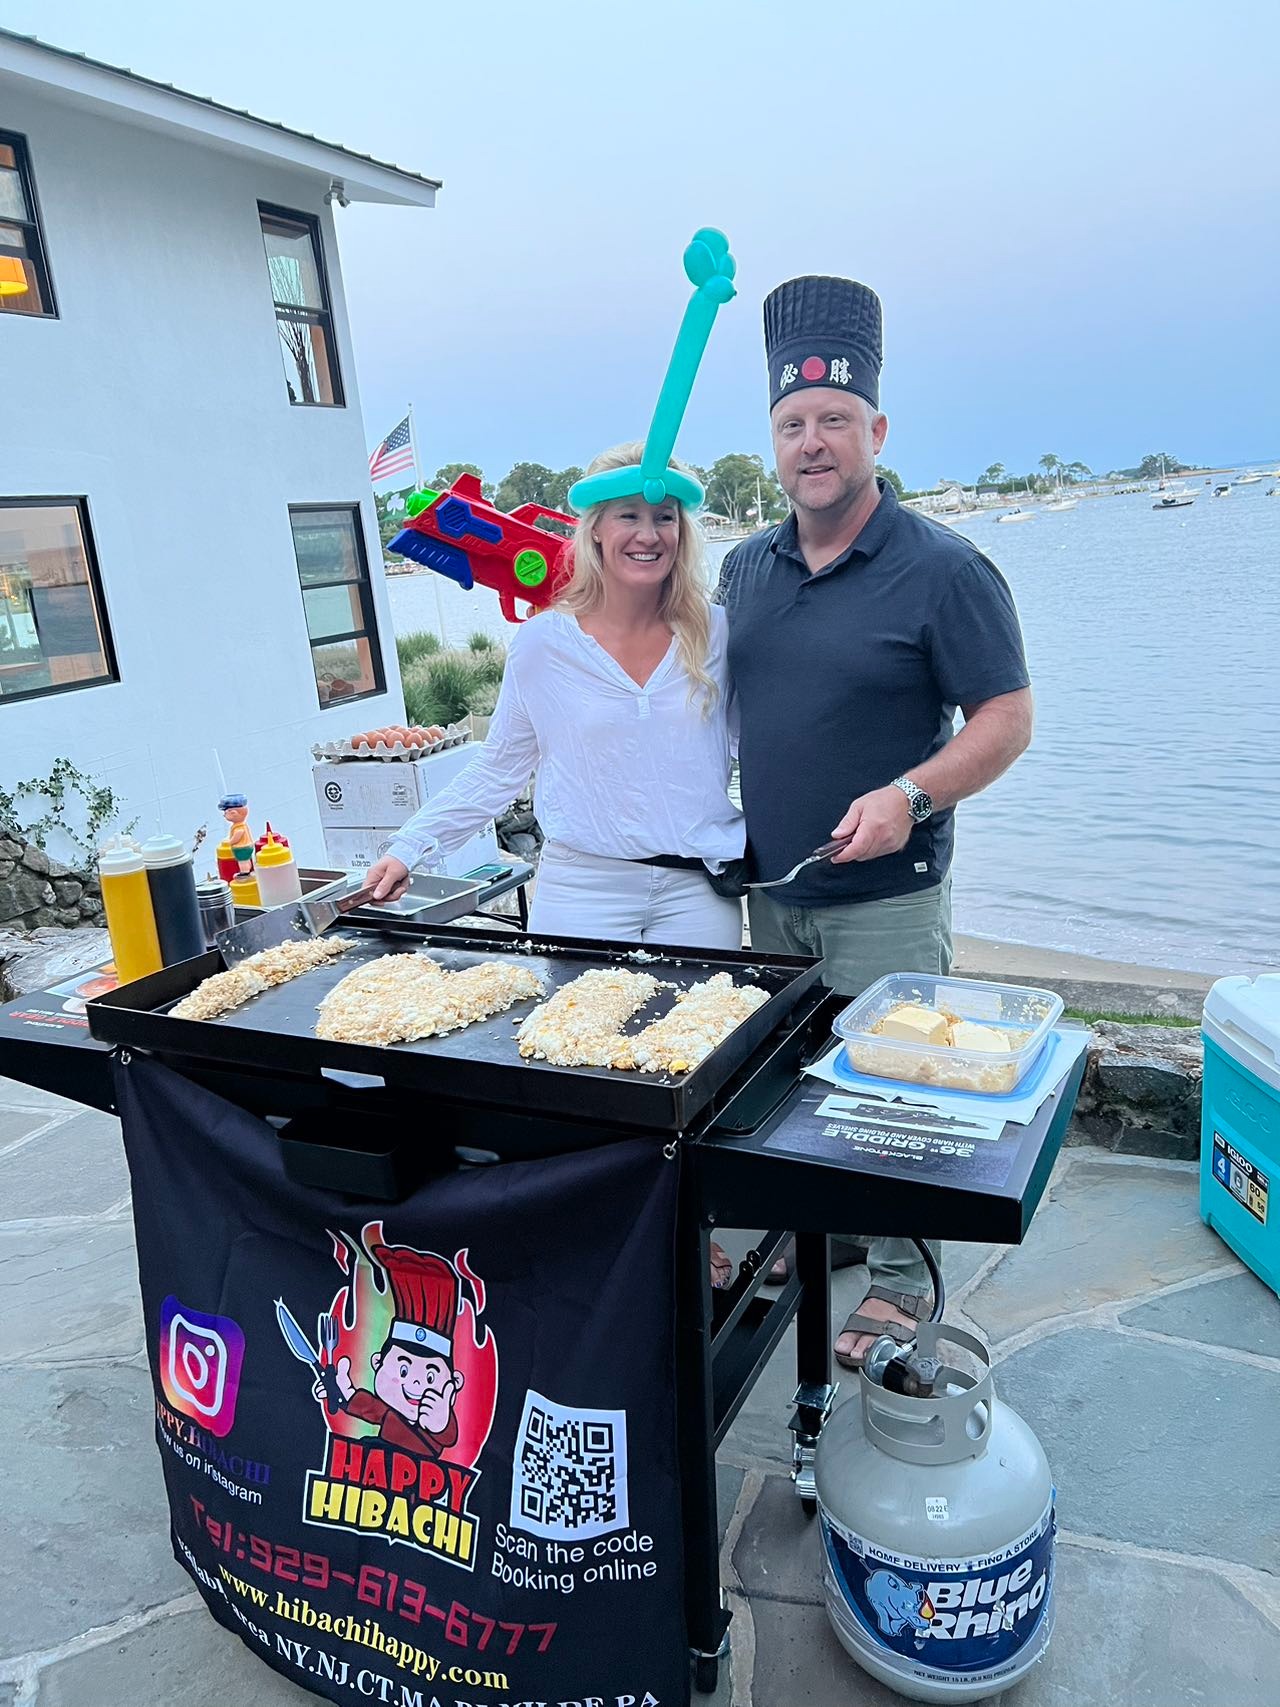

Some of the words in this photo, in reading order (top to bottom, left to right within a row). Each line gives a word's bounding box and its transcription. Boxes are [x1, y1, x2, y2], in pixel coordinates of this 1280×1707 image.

[821, 1128, 926, 1151] GRIDDLE
[827, 1122, 858, 1133] SHELVES
[858, 1127, 890, 1137] FOLDING
[890, 1131, 907, 1140] AND
[907, 1134, 932, 1144] COVER
[933, 1137, 954, 1147] HARD
[853, 1145, 924, 1161] BLACKSTONE
[955, 1140, 975, 1149] WITH
[1227, 1144, 1253, 1173] IGLOO
[173, 1441, 185, 1458] us
[186, 1453, 201, 1470] on
[329, 1439, 472, 1513] HAPPY
[310, 1480, 473, 1560] HIBACHI
[495, 1522, 538, 1562] Scan
[546, 1543, 585, 1564] the
[593, 1530, 654, 1556] code
[869, 1546, 900, 1565] HOME
[904, 1560, 961, 1572] DELIVERY
[978, 1554, 1003, 1568] FIND
[1005, 1549, 1013, 1559] A
[1014, 1529, 1039, 1553] STORE
[491, 1551, 575, 1593] Booking
[583, 1558, 658, 1583] online
[928, 1558, 1033, 1609] Blue
[915, 1573, 1047, 1640] Rhino
[218, 1563, 510, 1690] www.hibachihappy.com
[913, 1669, 926, 1677] NET
[927, 1673, 950, 1682] WEIGHT
